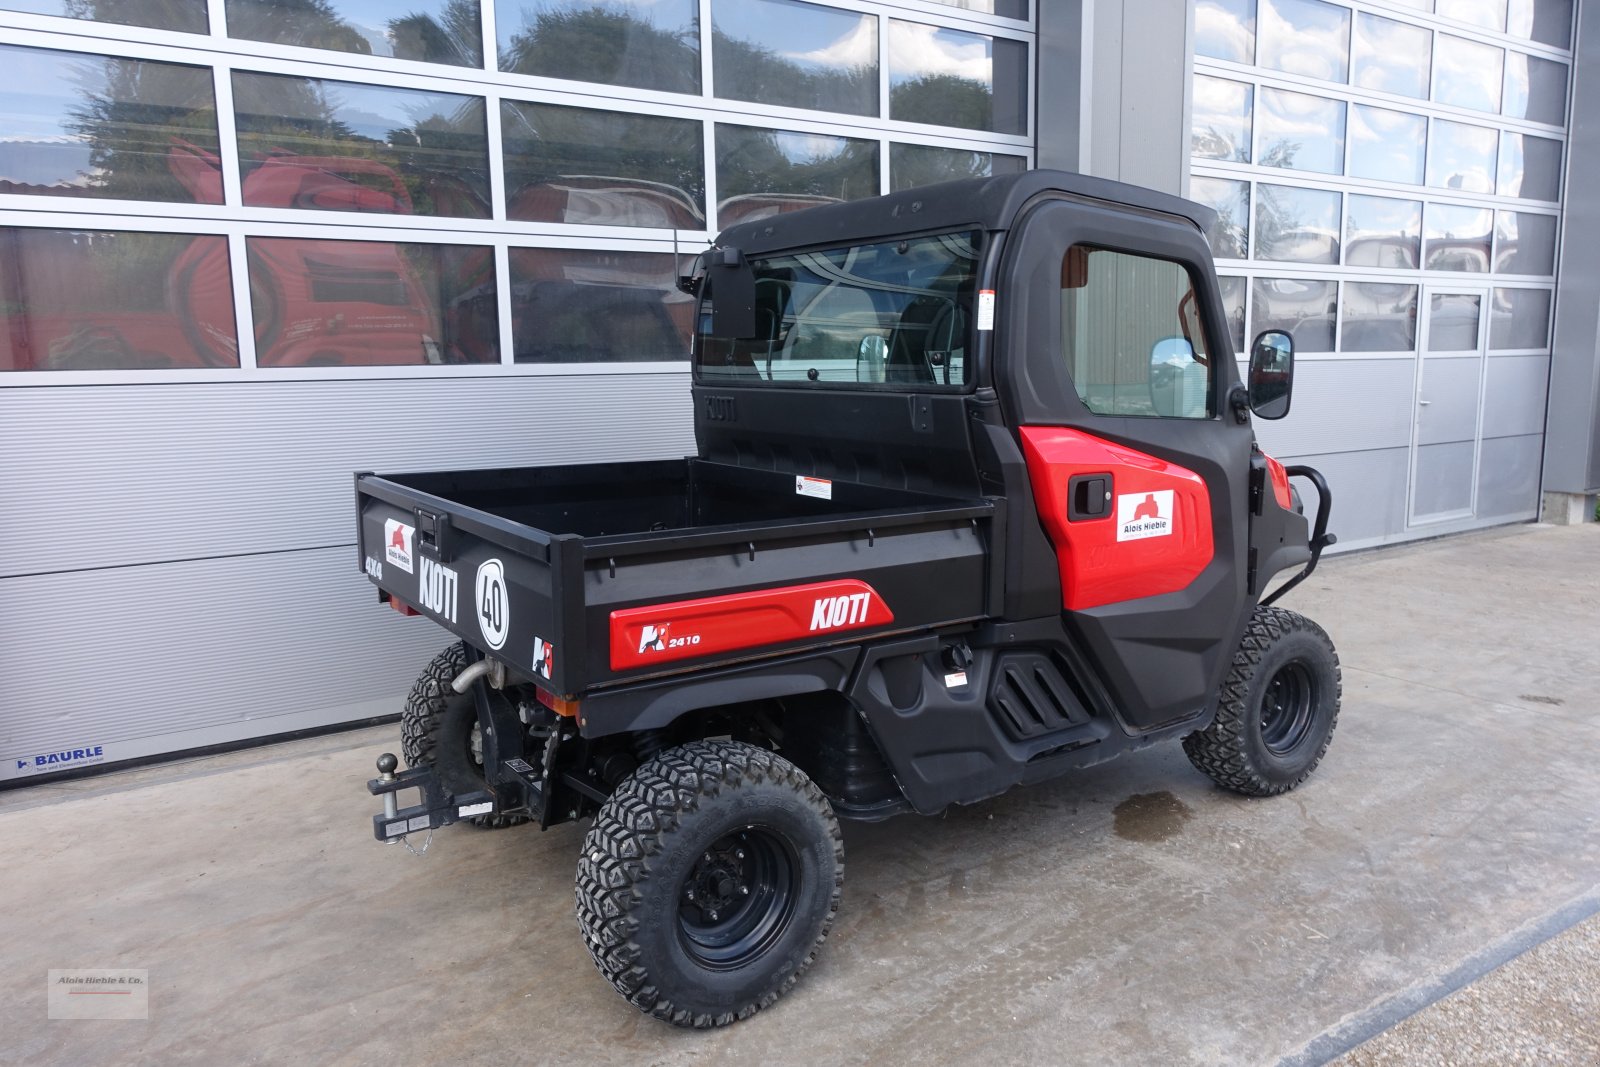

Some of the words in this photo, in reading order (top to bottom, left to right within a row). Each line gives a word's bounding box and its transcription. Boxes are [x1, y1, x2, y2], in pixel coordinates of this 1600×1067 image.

[1124, 524, 1142, 534] Alois
[1144, 521, 1167, 531] Hieble
[419, 556, 458, 624] KIOTI
[482, 575, 502, 634] 40
[809, 593, 871, 631] KIOTI
[669, 635, 700, 648] 2410
[35, 746, 103, 766] BÄURLE
